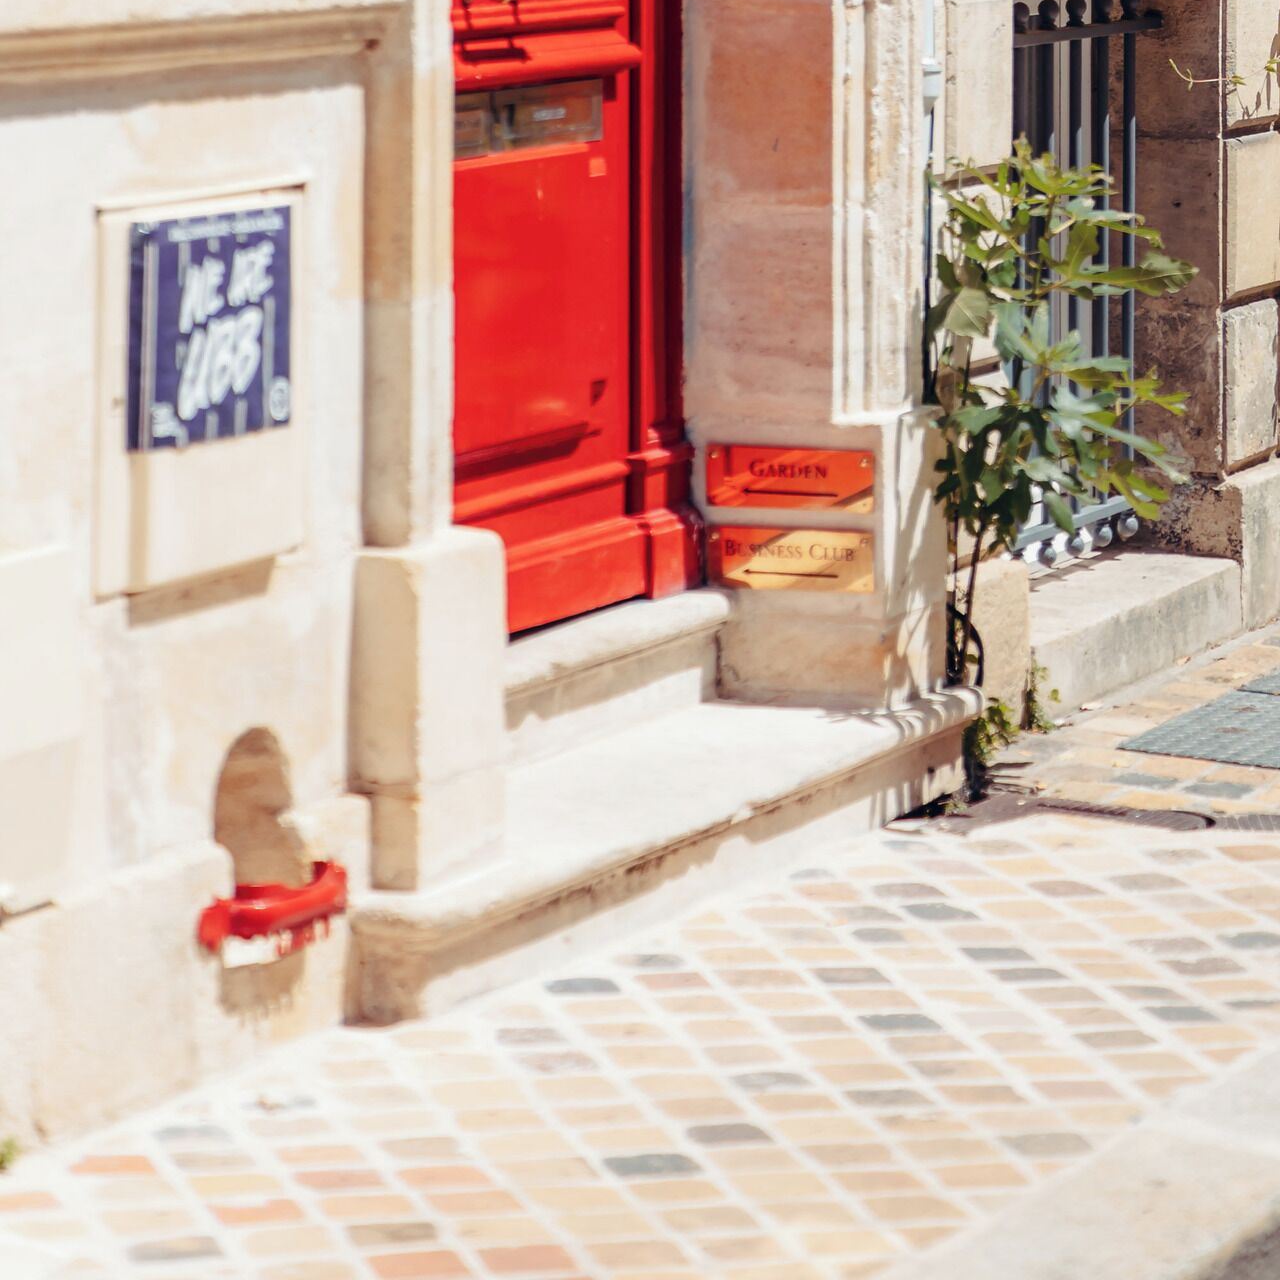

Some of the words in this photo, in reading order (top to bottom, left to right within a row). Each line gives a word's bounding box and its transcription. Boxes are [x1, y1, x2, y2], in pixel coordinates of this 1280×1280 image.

[750, 459, 829, 479] GARDEN
[723, 538, 803, 560] BUSINESS
[808, 543, 856, 562] CLUB
